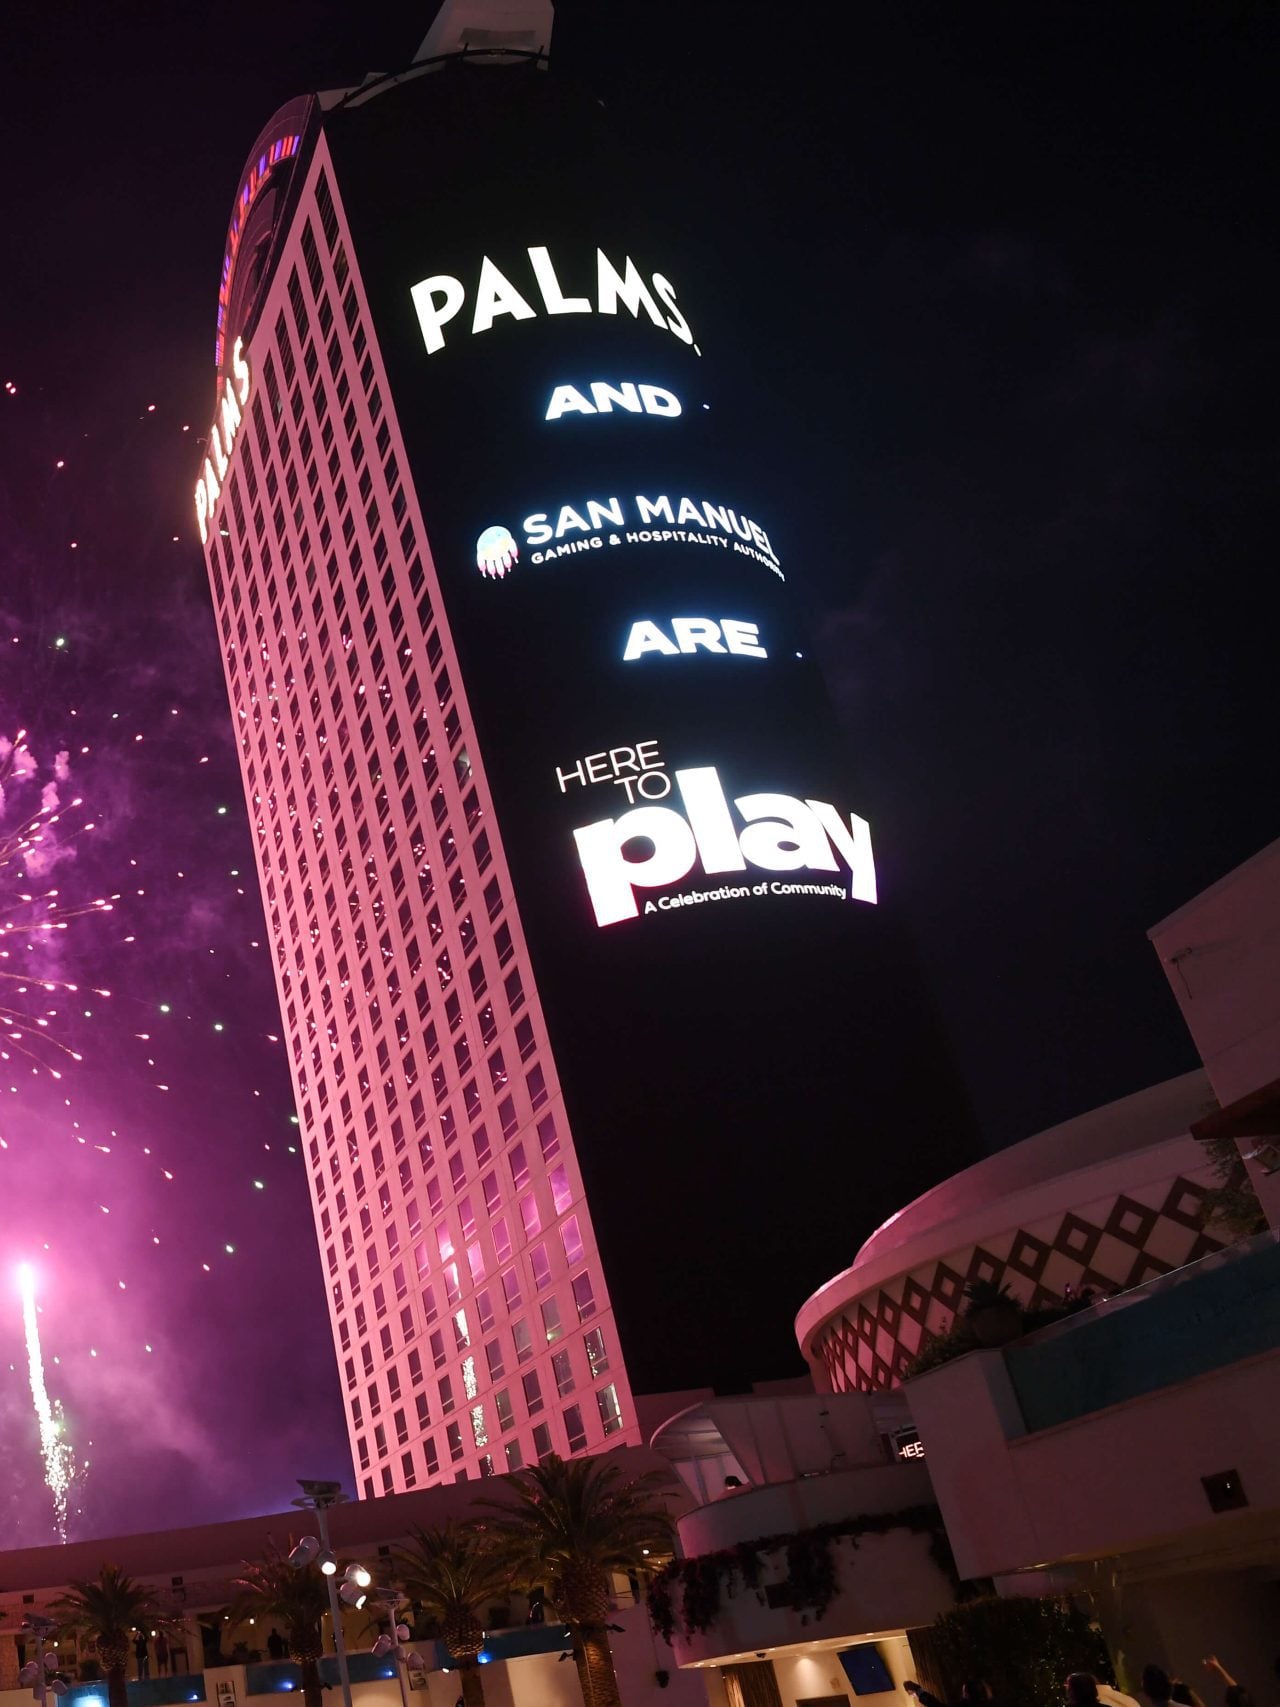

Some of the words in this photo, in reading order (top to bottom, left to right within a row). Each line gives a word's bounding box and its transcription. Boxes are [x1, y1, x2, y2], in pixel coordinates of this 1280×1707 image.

[410, 246, 695, 355] PALMS
[545, 381, 682, 421] AND
[522, 497, 625, 545] SAN
[635, 495, 780, 566] MANUEL
[530, 536, 603, 564] GAMING
[608, 533, 622, 546] &
[625, 530, 728, 549] HOSPITALITY
[622, 616, 768, 662] ARE
[555, 740, 665, 793] HERE
[613, 770, 671, 805] TO
[572, 766, 878, 928] play
[644, 900, 658, 915] A
[657, 885, 751, 910] Celebration
[752, 881, 769, 897] of
[770, 881, 847, 900] Community
